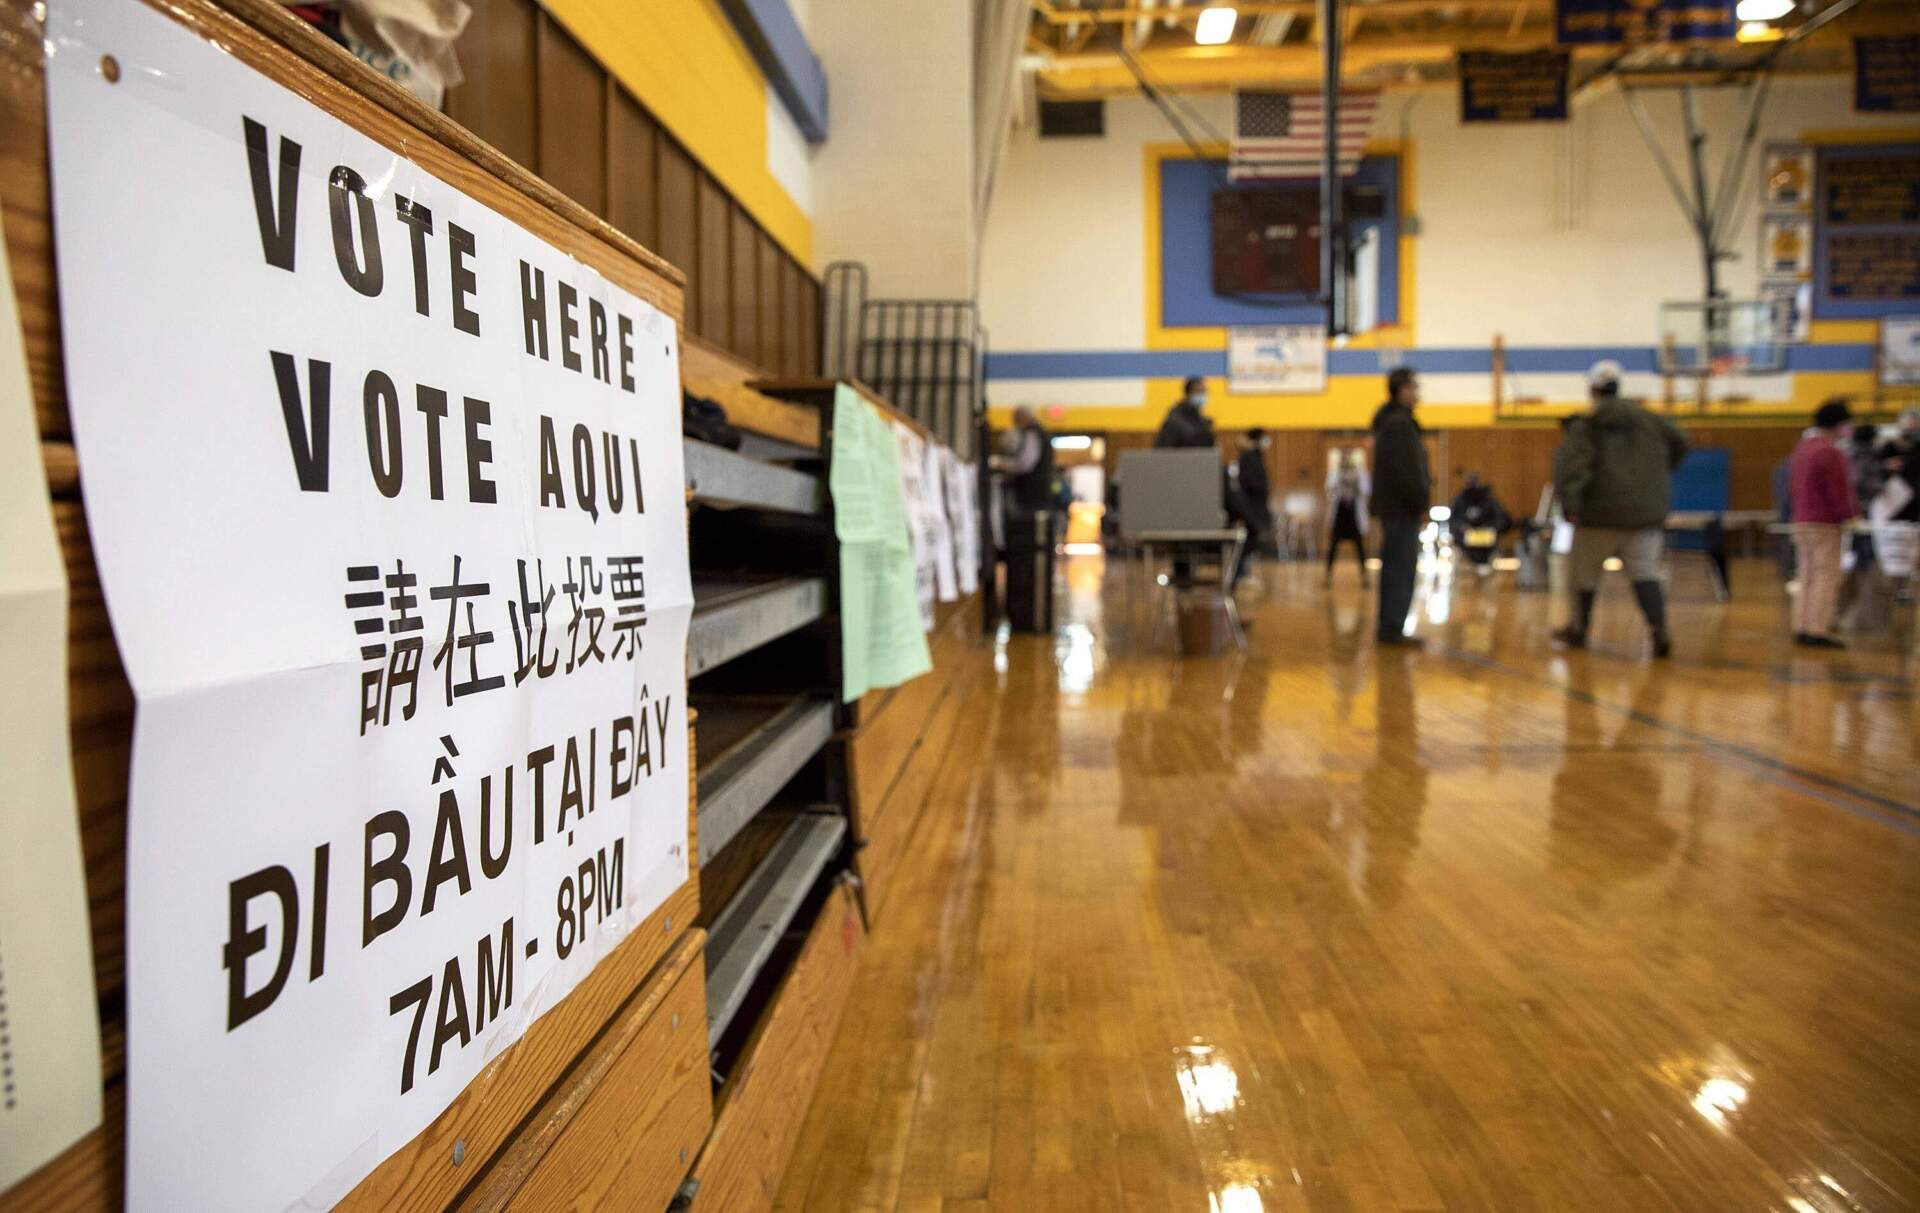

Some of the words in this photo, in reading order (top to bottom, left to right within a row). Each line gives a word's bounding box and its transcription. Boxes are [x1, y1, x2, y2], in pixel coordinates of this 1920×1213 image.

[242, 115, 480, 338] VOTE
[519, 259, 635, 393] HERE
[269, 350, 498, 504] VOTE
[539, 415, 645, 524] AQUI
[344, 554, 647, 737] 請在此投票
[222, 842, 331, 1032] ĐI
[362, 735, 514, 949] BẦU
[526, 728, 598, 847] TẠI
[609, 684, 671, 801] ĐÂY
[389, 915, 515, 1096] 7AM
[556, 837, 625, 961] 8PM
